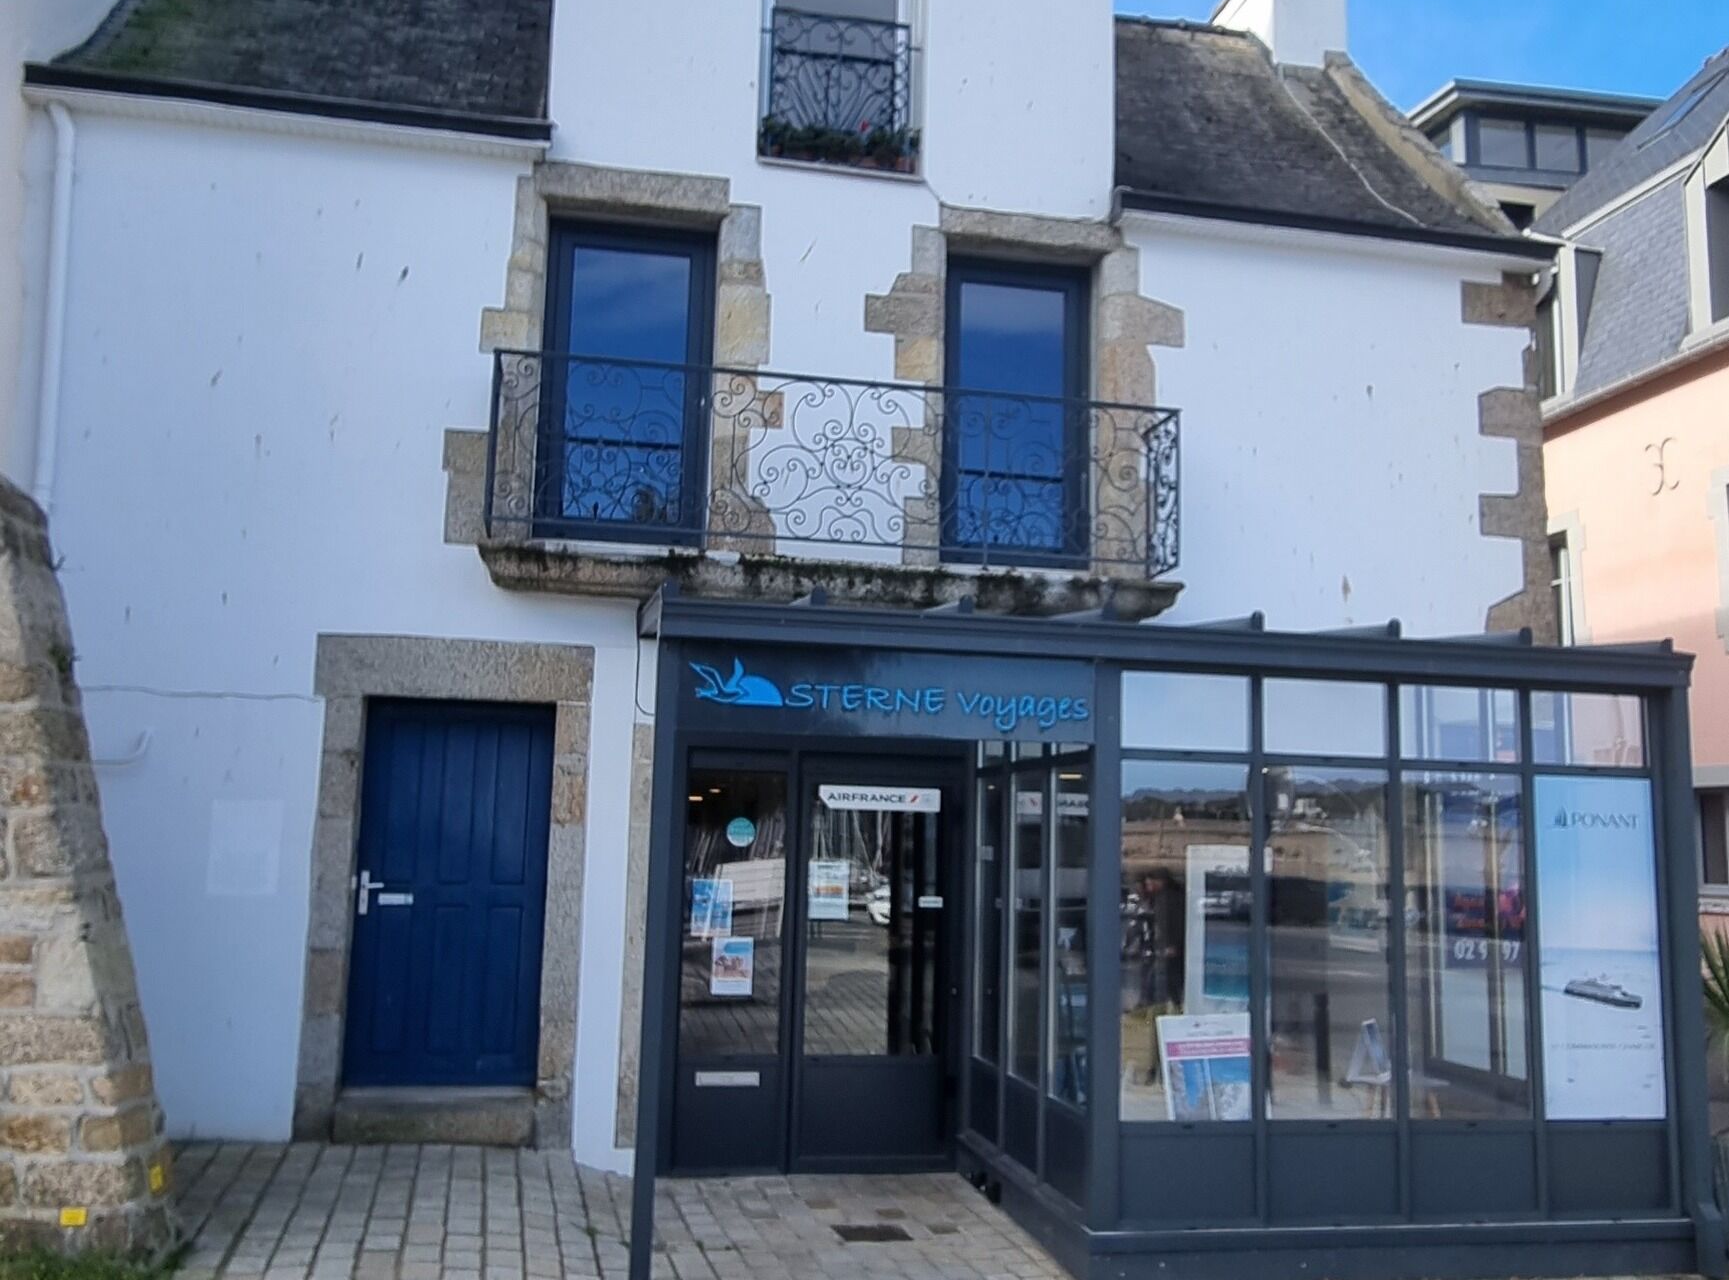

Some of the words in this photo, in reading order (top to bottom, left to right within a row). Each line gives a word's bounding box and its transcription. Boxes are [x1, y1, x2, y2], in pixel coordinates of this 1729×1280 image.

[785, 683, 945, 713] STERNE
[1571, 811, 1639, 830] PONANT
[1454, 939, 1475, 961] 02
